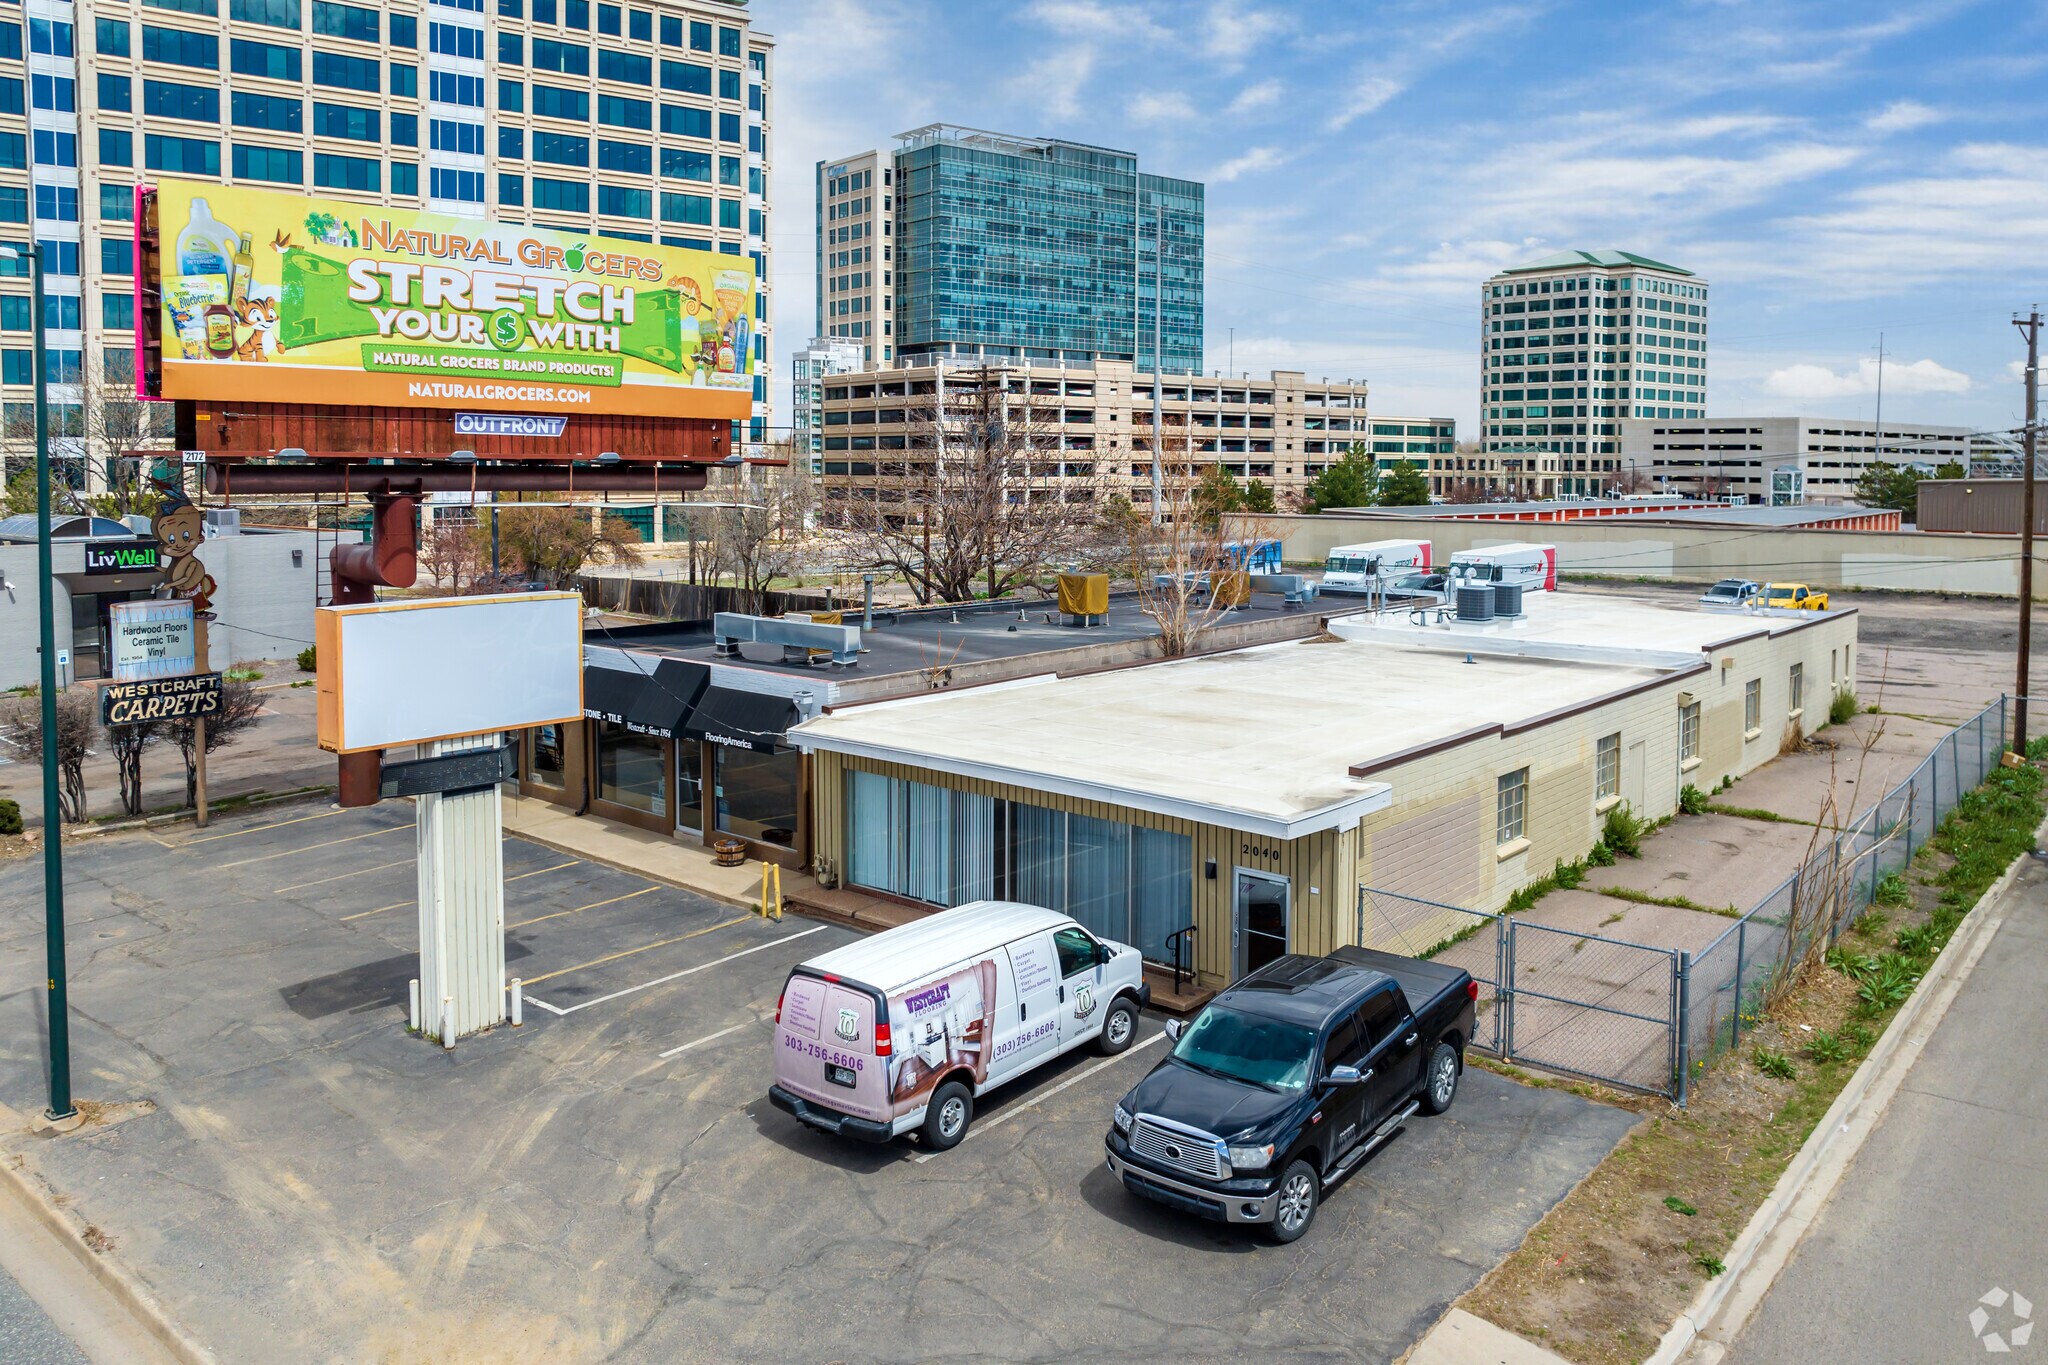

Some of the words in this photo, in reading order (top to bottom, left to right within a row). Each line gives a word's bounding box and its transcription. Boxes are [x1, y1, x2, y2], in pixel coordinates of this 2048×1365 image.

[360, 218, 512, 265] NATURAL
[347, 258, 635, 324] STRETCH
[369, 306, 485, 343] YOUR
[527, 320, 621, 352] WITH
[373, 352, 437, 367] NATURAL
[440, 355, 500, 371] GROCERS
[503, 358, 546, 373] BRAND
[549, 361, 615, 377] PRODUCTS!
[409, 382, 591, 403] NATURALGROCERS.COM
[459, 415, 562, 434] OUTFRONT
[88, 549, 156, 567] LivWell
[123, 624, 161, 636] Hardwood
[164, 623, 188, 633] Floors
[132, 635, 163, 647] Ceramic
[166, 634, 180, 644] Tile
[147, 647, 166, 658] Vinyl
[108, 677, 217, 699] WESTCRAFT
[110, 691, 219, 723] CARPETS
[607, 712, 622, 724] TILE
[626, 721, 645, 732] Westcraft
[648, 726, 659, 736] Since
[660, 728, 671, 739] 1954
[1242, 844, 1280, 861] 2040
[905, 983, 951, 1014] WESTCRAFT
[914, 1000, 947, 1018] FLOORING
[993, 1020, 1055, 1060] (303)756-6606
[785, 1034, 864, 1071] 303-756-6606
